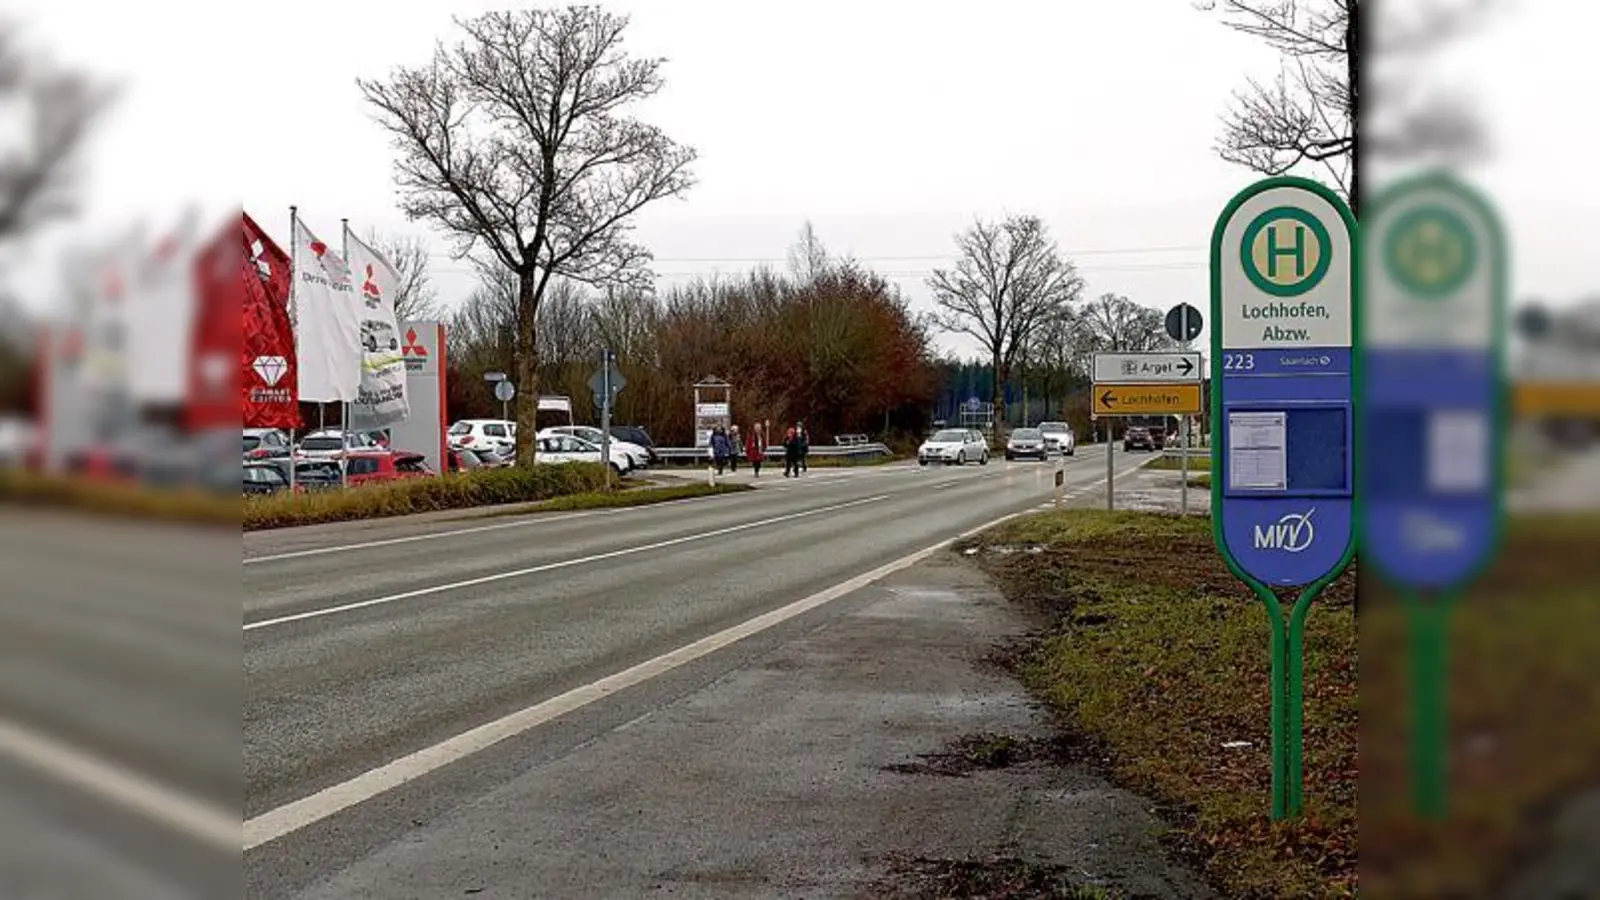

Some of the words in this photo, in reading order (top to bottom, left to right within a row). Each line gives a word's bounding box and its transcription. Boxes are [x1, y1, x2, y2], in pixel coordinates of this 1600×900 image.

[1267, 226, 1305, 277] H
[1242, 303, 1330, 320] Lochhofen,
[1262, 326, 1311, 341] Abzw.
[1224, 354, 1255, 370] 223
[1255, 515, 1312, 551] MVV
